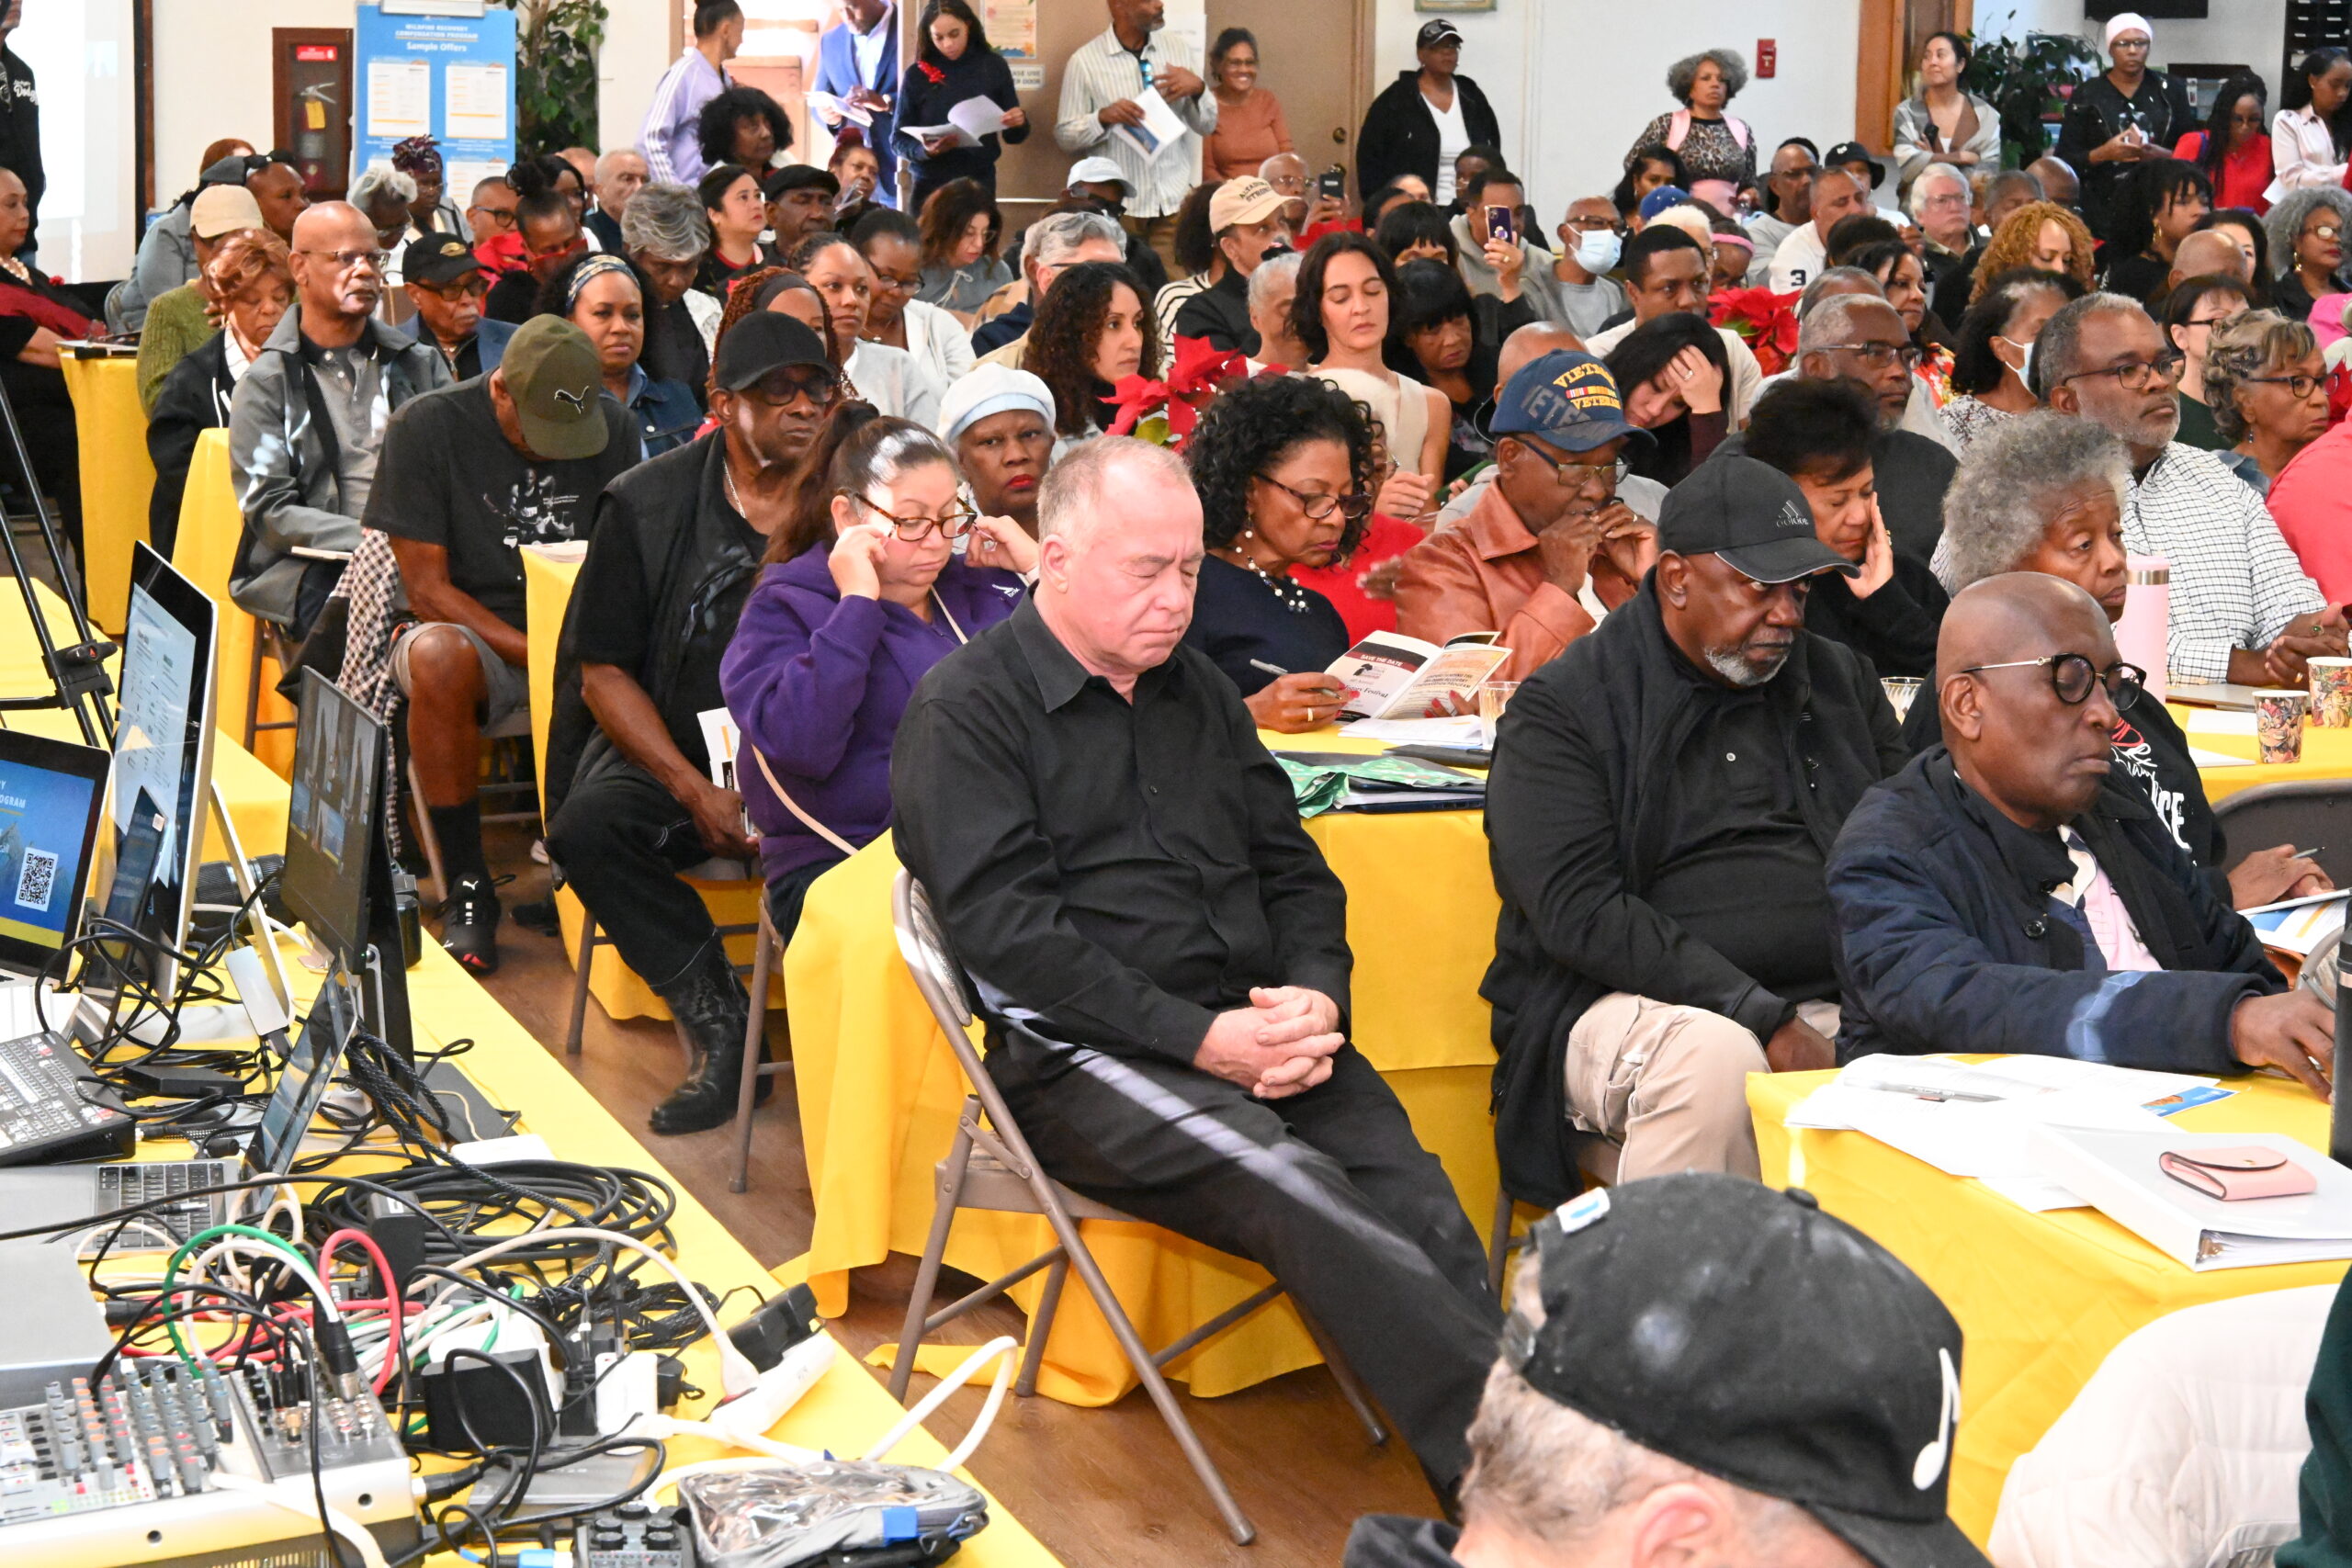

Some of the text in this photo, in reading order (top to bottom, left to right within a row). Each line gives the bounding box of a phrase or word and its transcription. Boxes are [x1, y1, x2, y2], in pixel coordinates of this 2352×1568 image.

[406, 41, 468, 52] Sample Offers
[1790, 269, 1806, 286] 3
[1386, 659, 1404, 667] DATE
[1363, 687, 1389, 698] Festival
